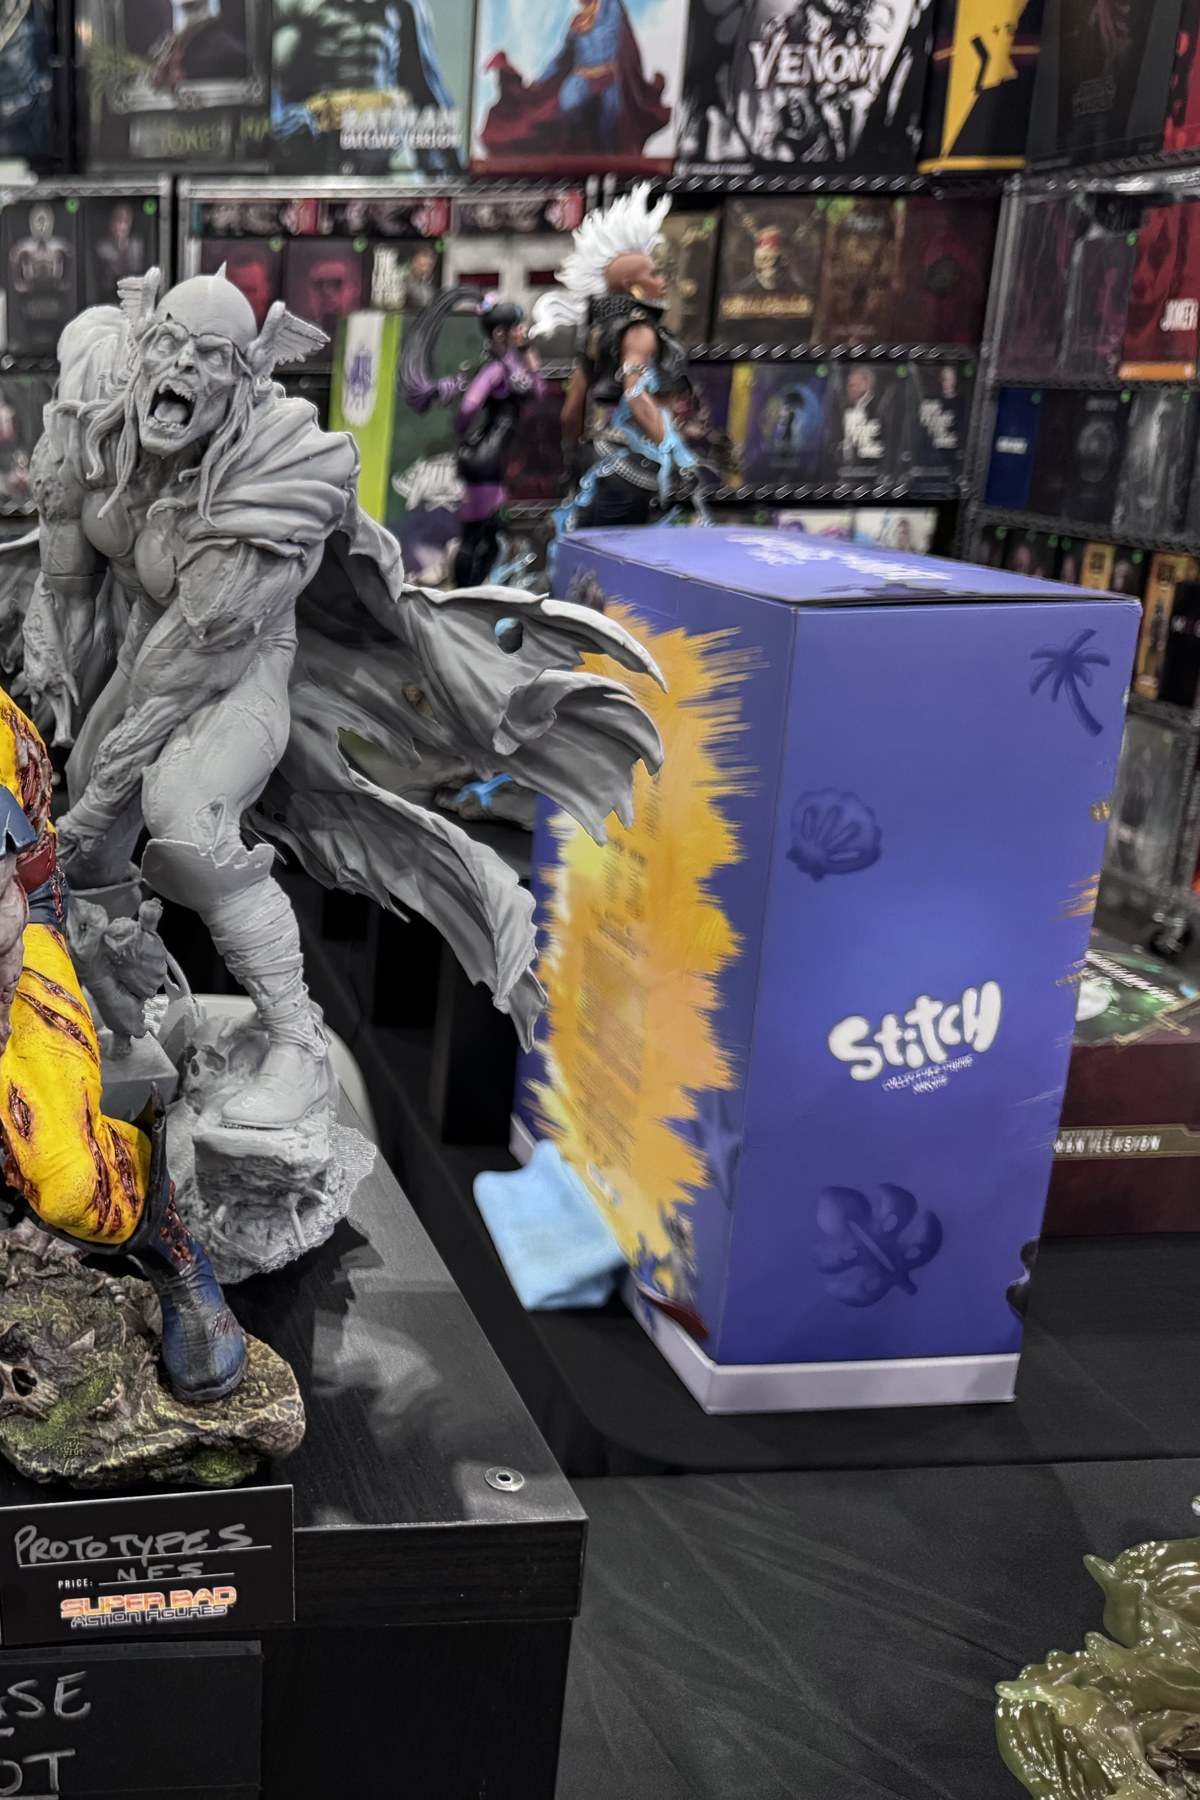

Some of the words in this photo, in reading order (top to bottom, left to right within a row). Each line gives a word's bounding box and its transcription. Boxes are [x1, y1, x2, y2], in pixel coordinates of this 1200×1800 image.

[750, 32, 887, 90] VENOM
[14, 1523, 254, 1567] PROTOTYPES
[57, 1578, 94, 1590] PRICE:
[117, 1561, 204, 1582] NFS
[60, 1591, 166, 1619] SUPER
[170, 1586, 237, 1608] BAD
[70, 1611, 142, 1628] ACTION
[145, 1605, 229, 1623] FIGURES
